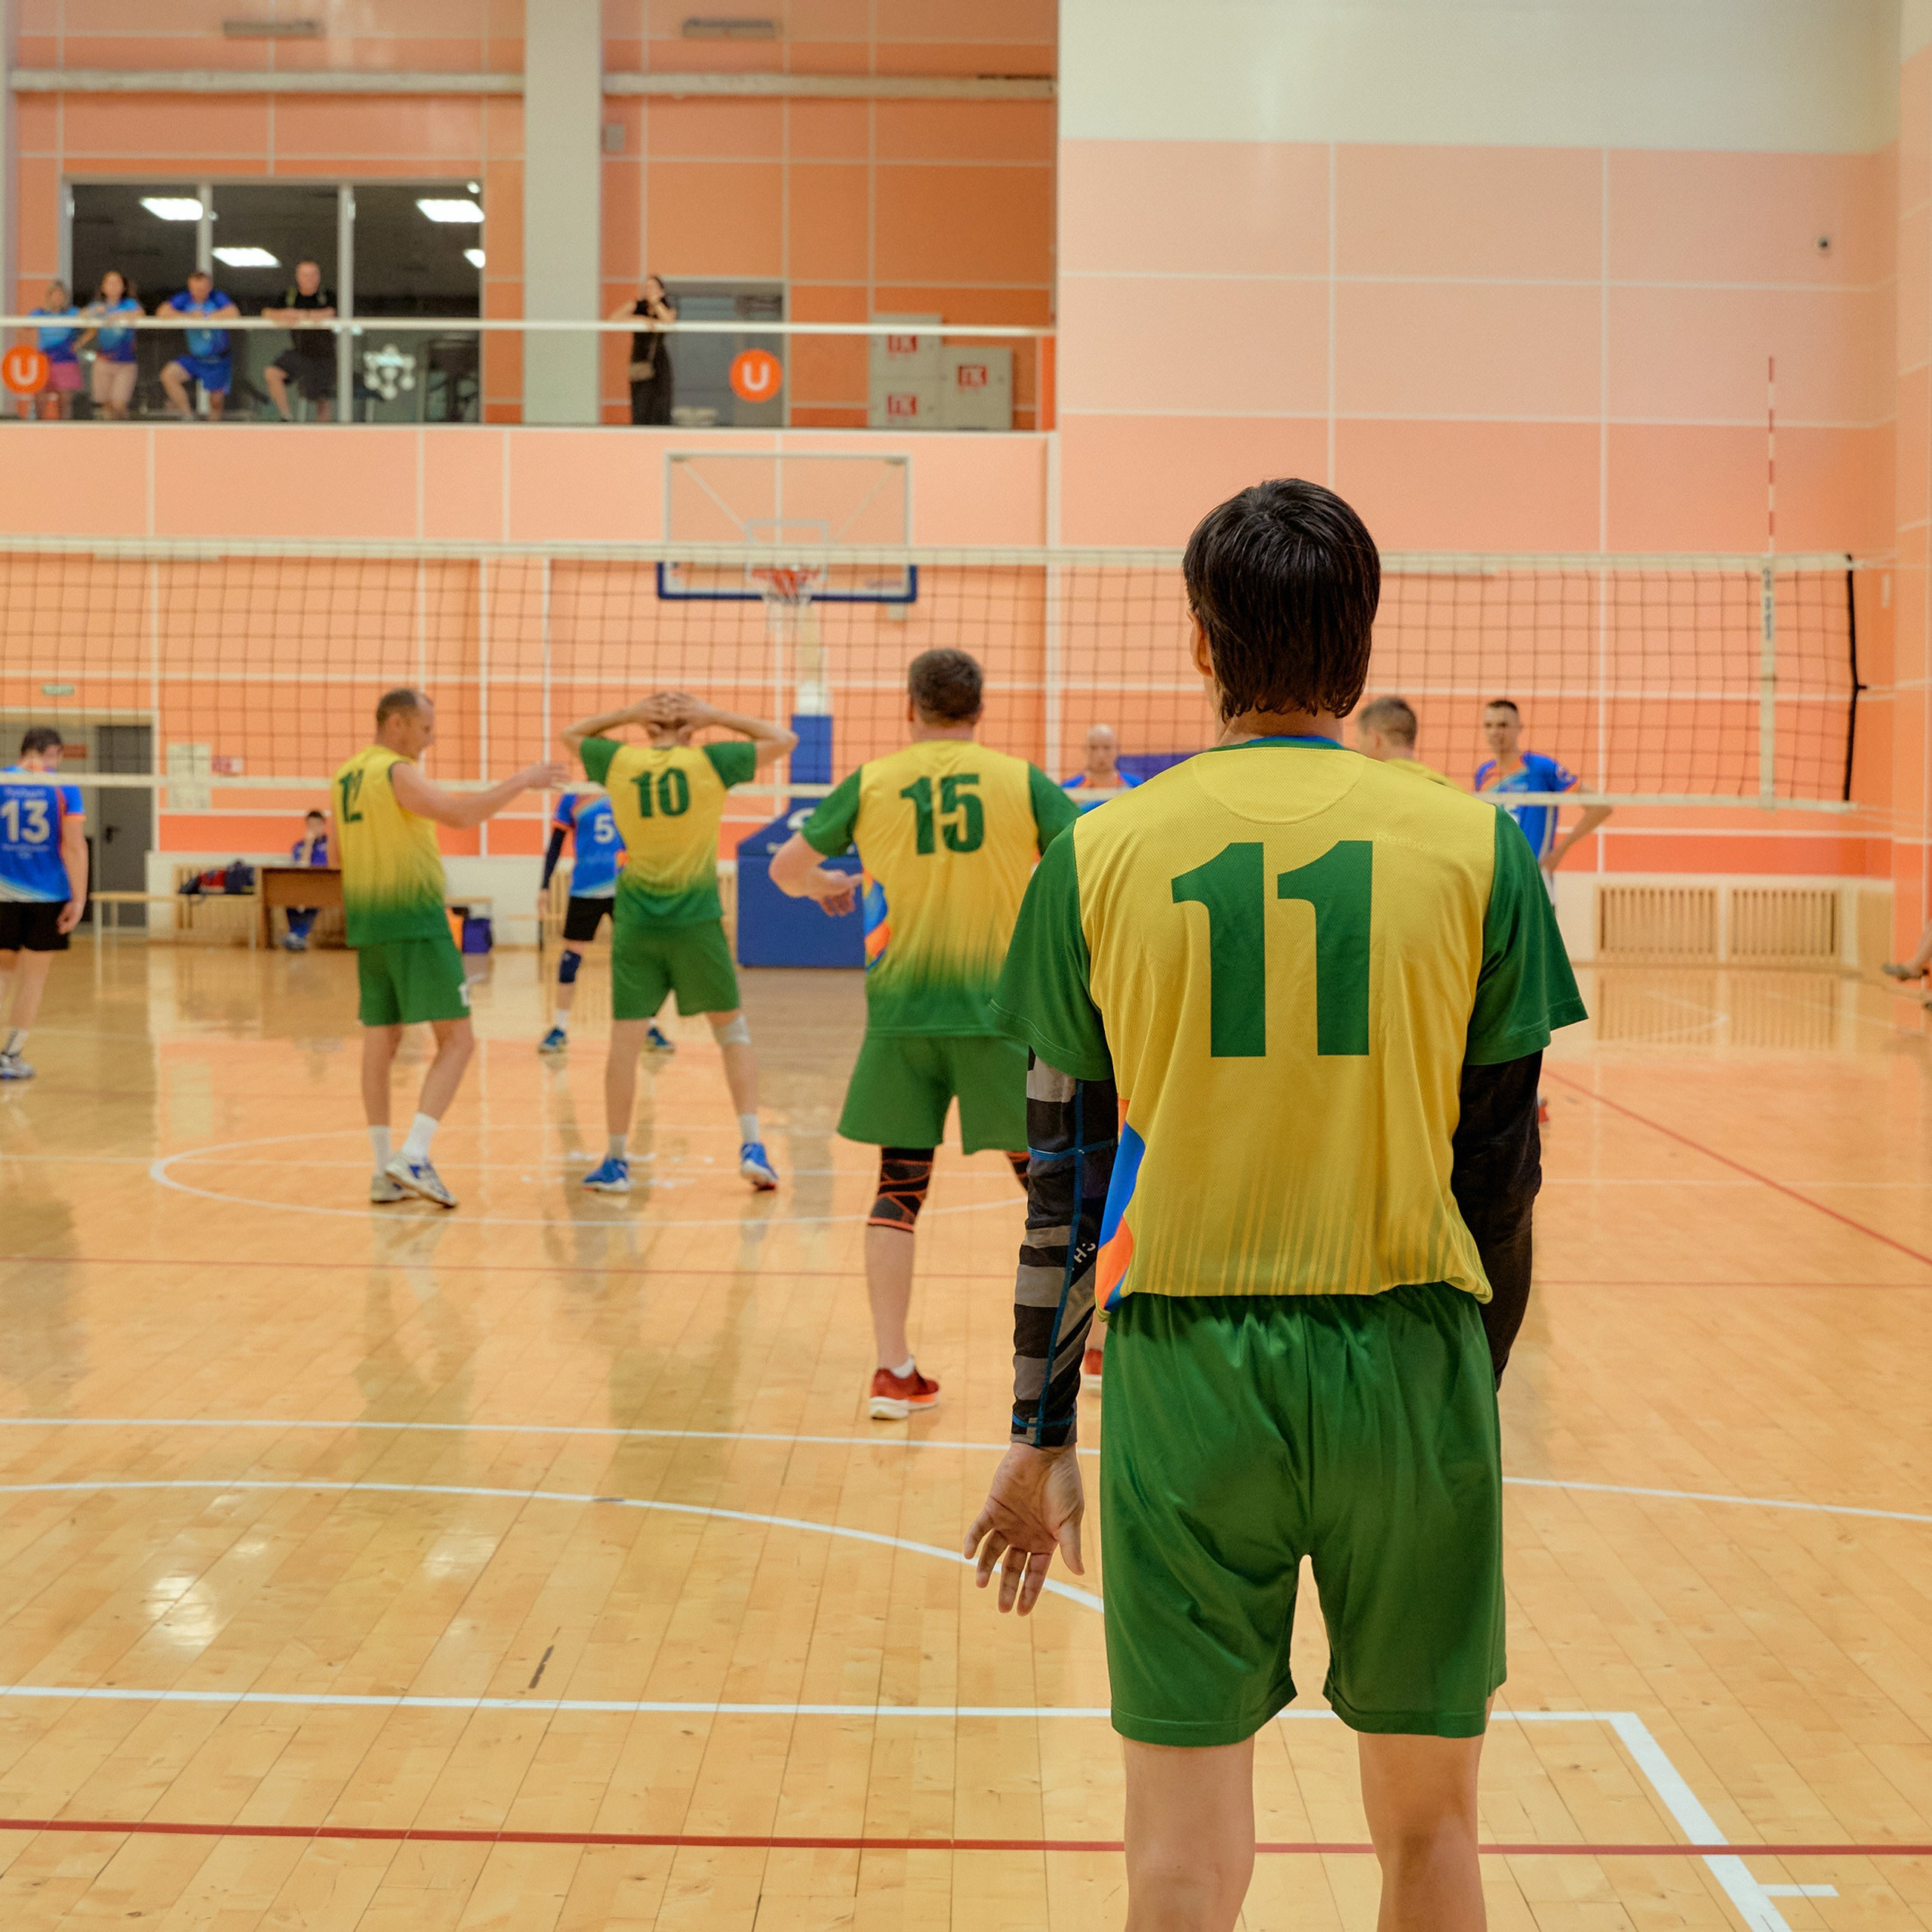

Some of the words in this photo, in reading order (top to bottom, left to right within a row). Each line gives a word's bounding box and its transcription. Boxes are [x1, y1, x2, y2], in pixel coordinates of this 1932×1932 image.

[11, 355, 38, 385] U
[743, 362, 769, 391] U
[339, 770, 363, 823] 12
[631, 768, 689, 817] 10
[900, 774, 984, 854] 15
[0, 800, 50, 843] 13
[594, 814, 615, 844] 5
[1171, 840, 1373, 1057] 11
